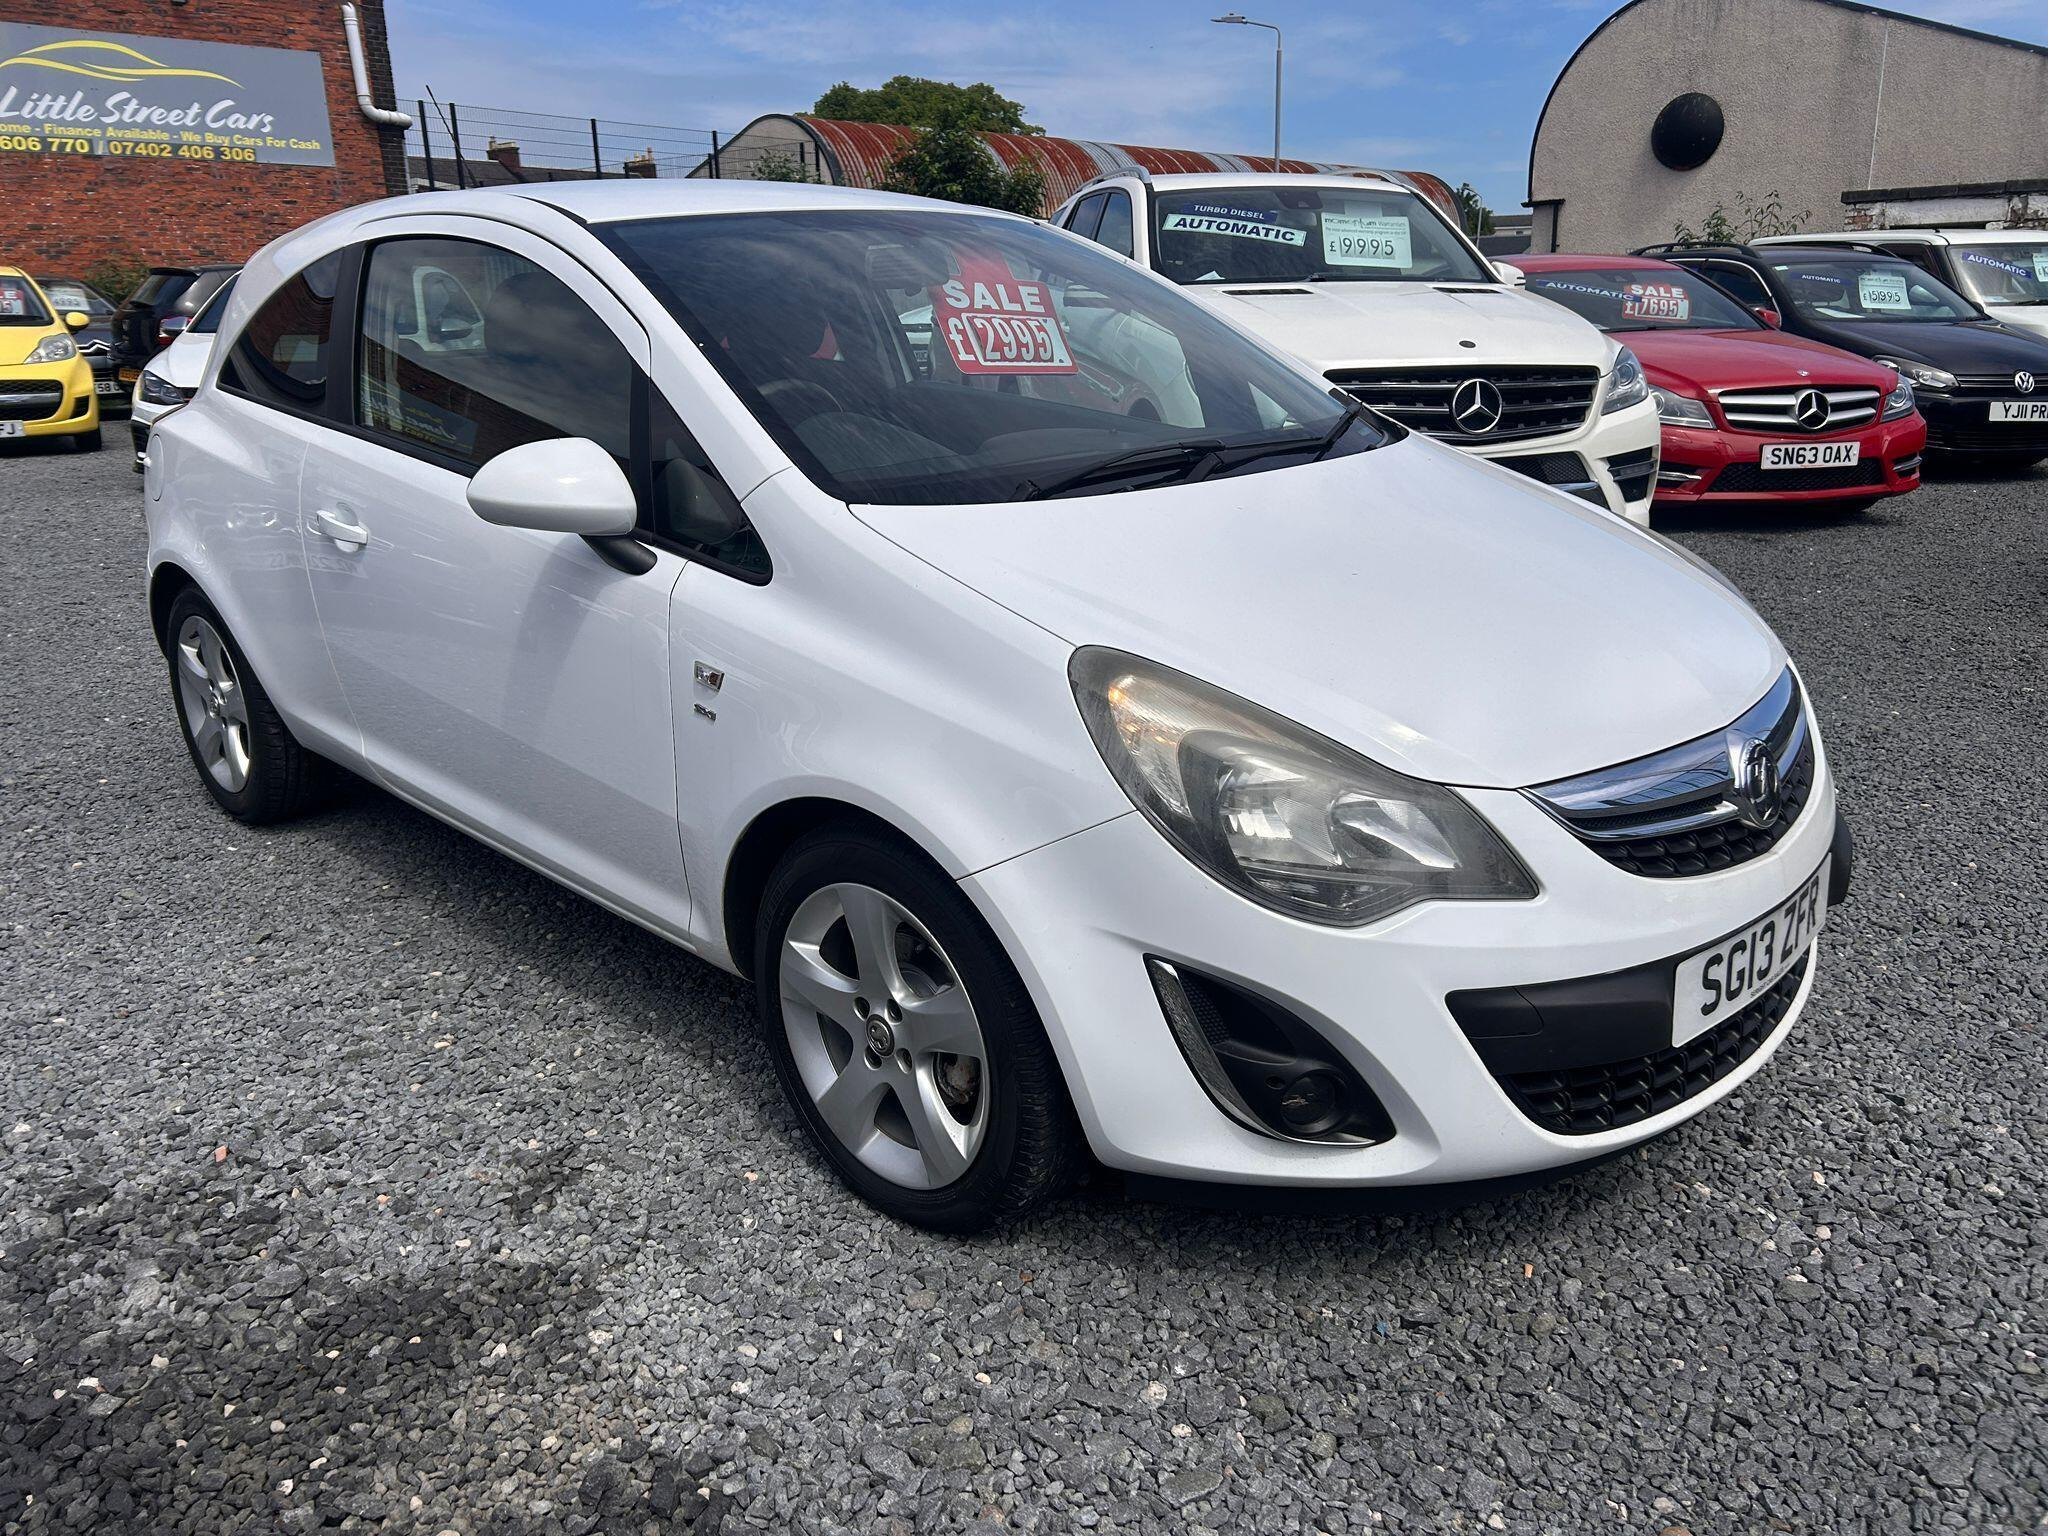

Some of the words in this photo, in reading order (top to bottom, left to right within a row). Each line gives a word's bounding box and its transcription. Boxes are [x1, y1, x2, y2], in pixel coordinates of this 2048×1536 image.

[0, 85, 98, 122] Little
[100, 91, 202, 126] Street
[204, 99, 274, 133] Cars
[43, 123, 101, 137] Finance
[106, 126, 169, 140] Available
[180, 131, 201, 142] We
[204, 132, 230, 146] Buy
[232, 134, 263, 146] Cars
[265, 137, 287, 148] For
[289, 138, 321, 150] Cash
[0, 135, 42, 151] 606
[47, 138, 90, 153] 770
[109, 141, 172, 157] 07402
[178, 145, 215, 159] 406
[220, 147, 256, 161] 306
[1193, 204, 1228, 214] TURBO
[1231, 208, 1265, 220] DIESEL
[1174, 217, 1295, 242] AUTOMATIC
[1967, 254, 2027, 276] AUTOMATIC
[1801, 274, 1840, 284] AUTOMATIC
[943, 280, 1046, 313] SALE
[1546, 281, 1634, 300] AUTOMATIC
[1631, 284, 1685, 299] SALE
[2004, 404, 2028, 418] YJ11
[2030, 404, 2048, 418] PR
[1770, 446, 1819, 465] SN63
[1822, 445, 1853, 463] OAX
[1701, 920, 1776, 1016] SG13
[1780, 875, 1819, 964] ZFR
